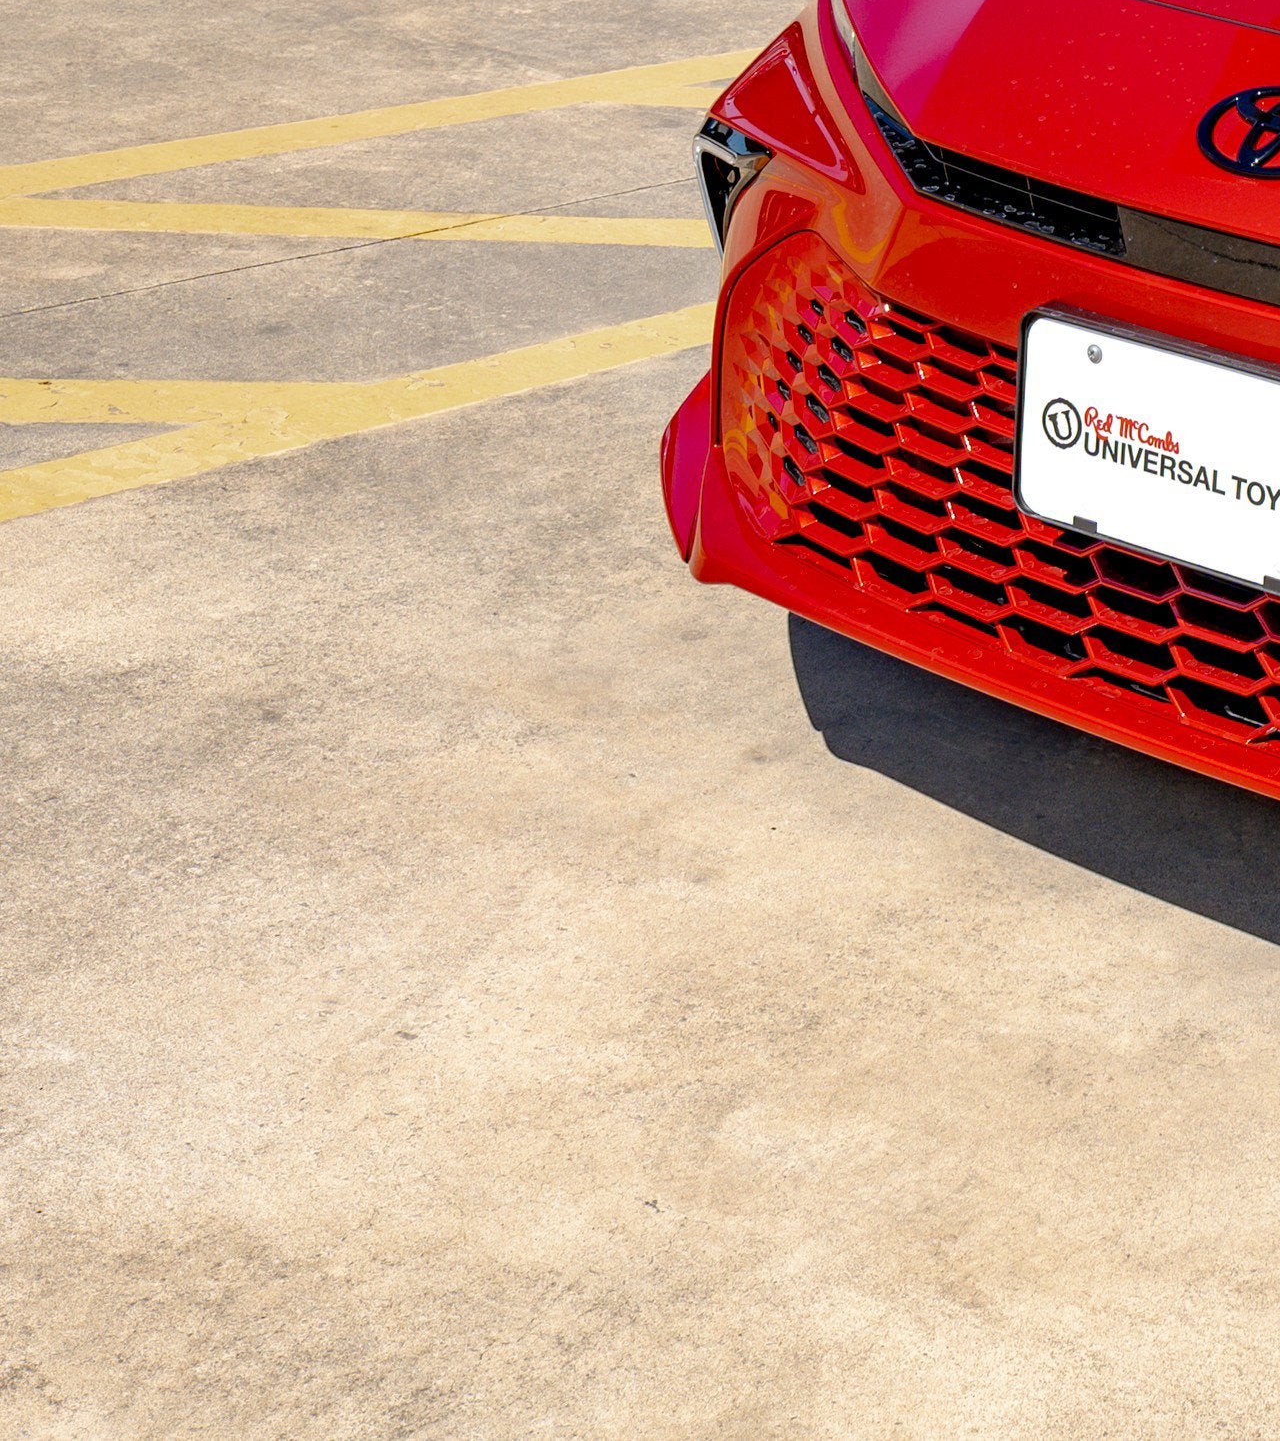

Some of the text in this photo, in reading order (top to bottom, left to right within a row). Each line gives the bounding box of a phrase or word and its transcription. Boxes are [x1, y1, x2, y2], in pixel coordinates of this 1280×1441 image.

[1084, 406, 1180, 455] Red McCombs
[1084, 431, 1226, 496] UNIVERSAL
